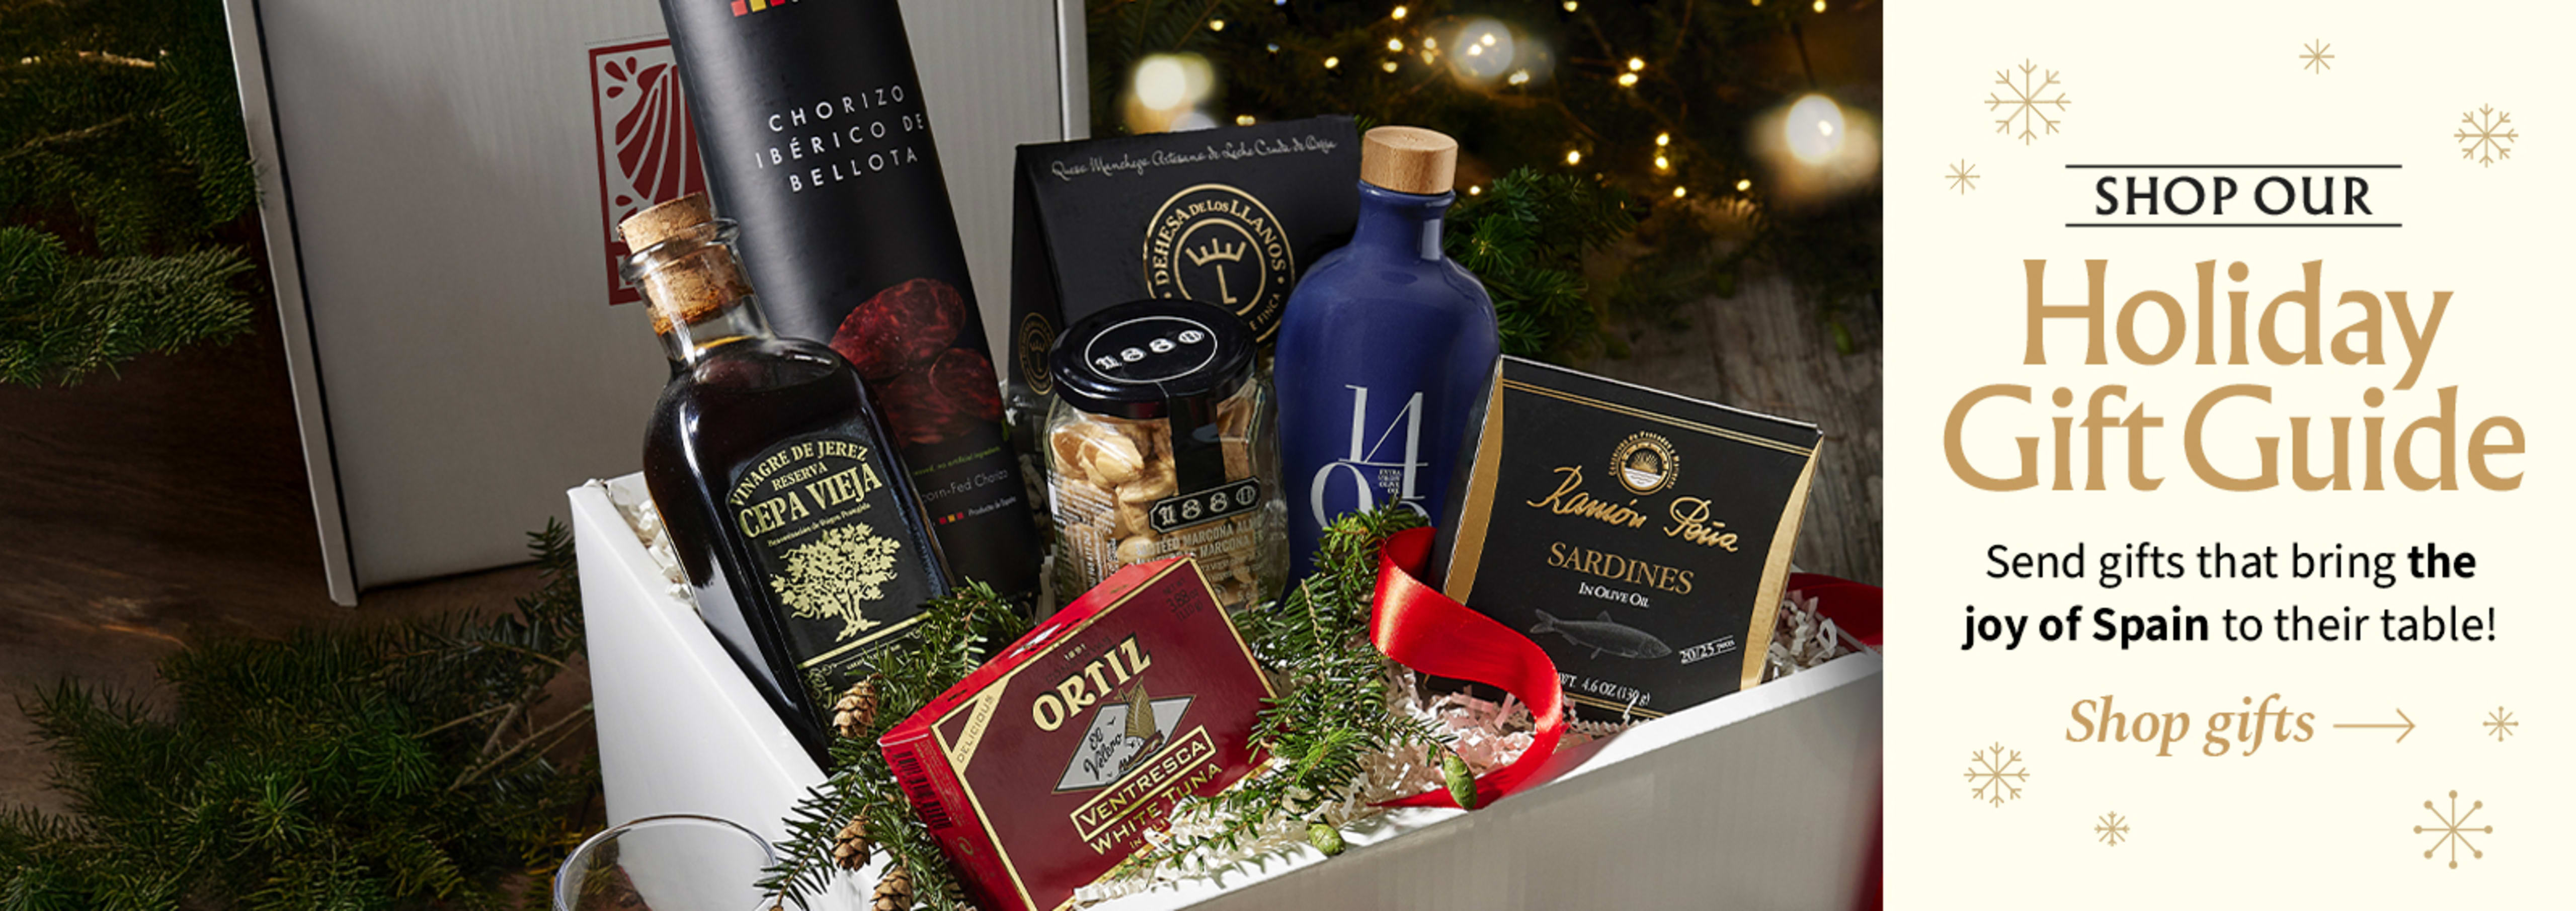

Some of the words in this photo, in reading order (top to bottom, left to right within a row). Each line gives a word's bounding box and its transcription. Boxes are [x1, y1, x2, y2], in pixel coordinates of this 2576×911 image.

[769, 85, 904, 132] CHORIZO
[755, 121, 886, 169] IBÉRICO
[902, 113, 924, 132] DE
[789, 147, 917, 193] BELLOTA
[1152, 208, 1190, 287] DEHESA
[1188, 201, 1206, 216] DE
[1206, 200, 1229, 212] LOS
[1230, 199, 1286, 272] LLANOS
[730, 450, 790, 506] VINAGRE
[790, 442, 814, 461] DE
[817, 441, 868, 461] JEREZ
[739, 490, 811, 538] CEPA
[805, 462, 882, 510] VIEJA
[771, 461, 828, 491] RESERVA
[921, 478, 972, 503] corn-Fed
[1526, 465, 1648, 529] Ramón
[1547, 541, 1695, 595] SARDINES
[1032, 632, 1152, 731] ORTIZ
[957, 695, 994, 763] DELICIOUS
[1080, 740, 1207, 826] VENTRESCA
[1090, 801, 1163, 855] WHITE
[1160, 763, 1222, 804] TUNA
